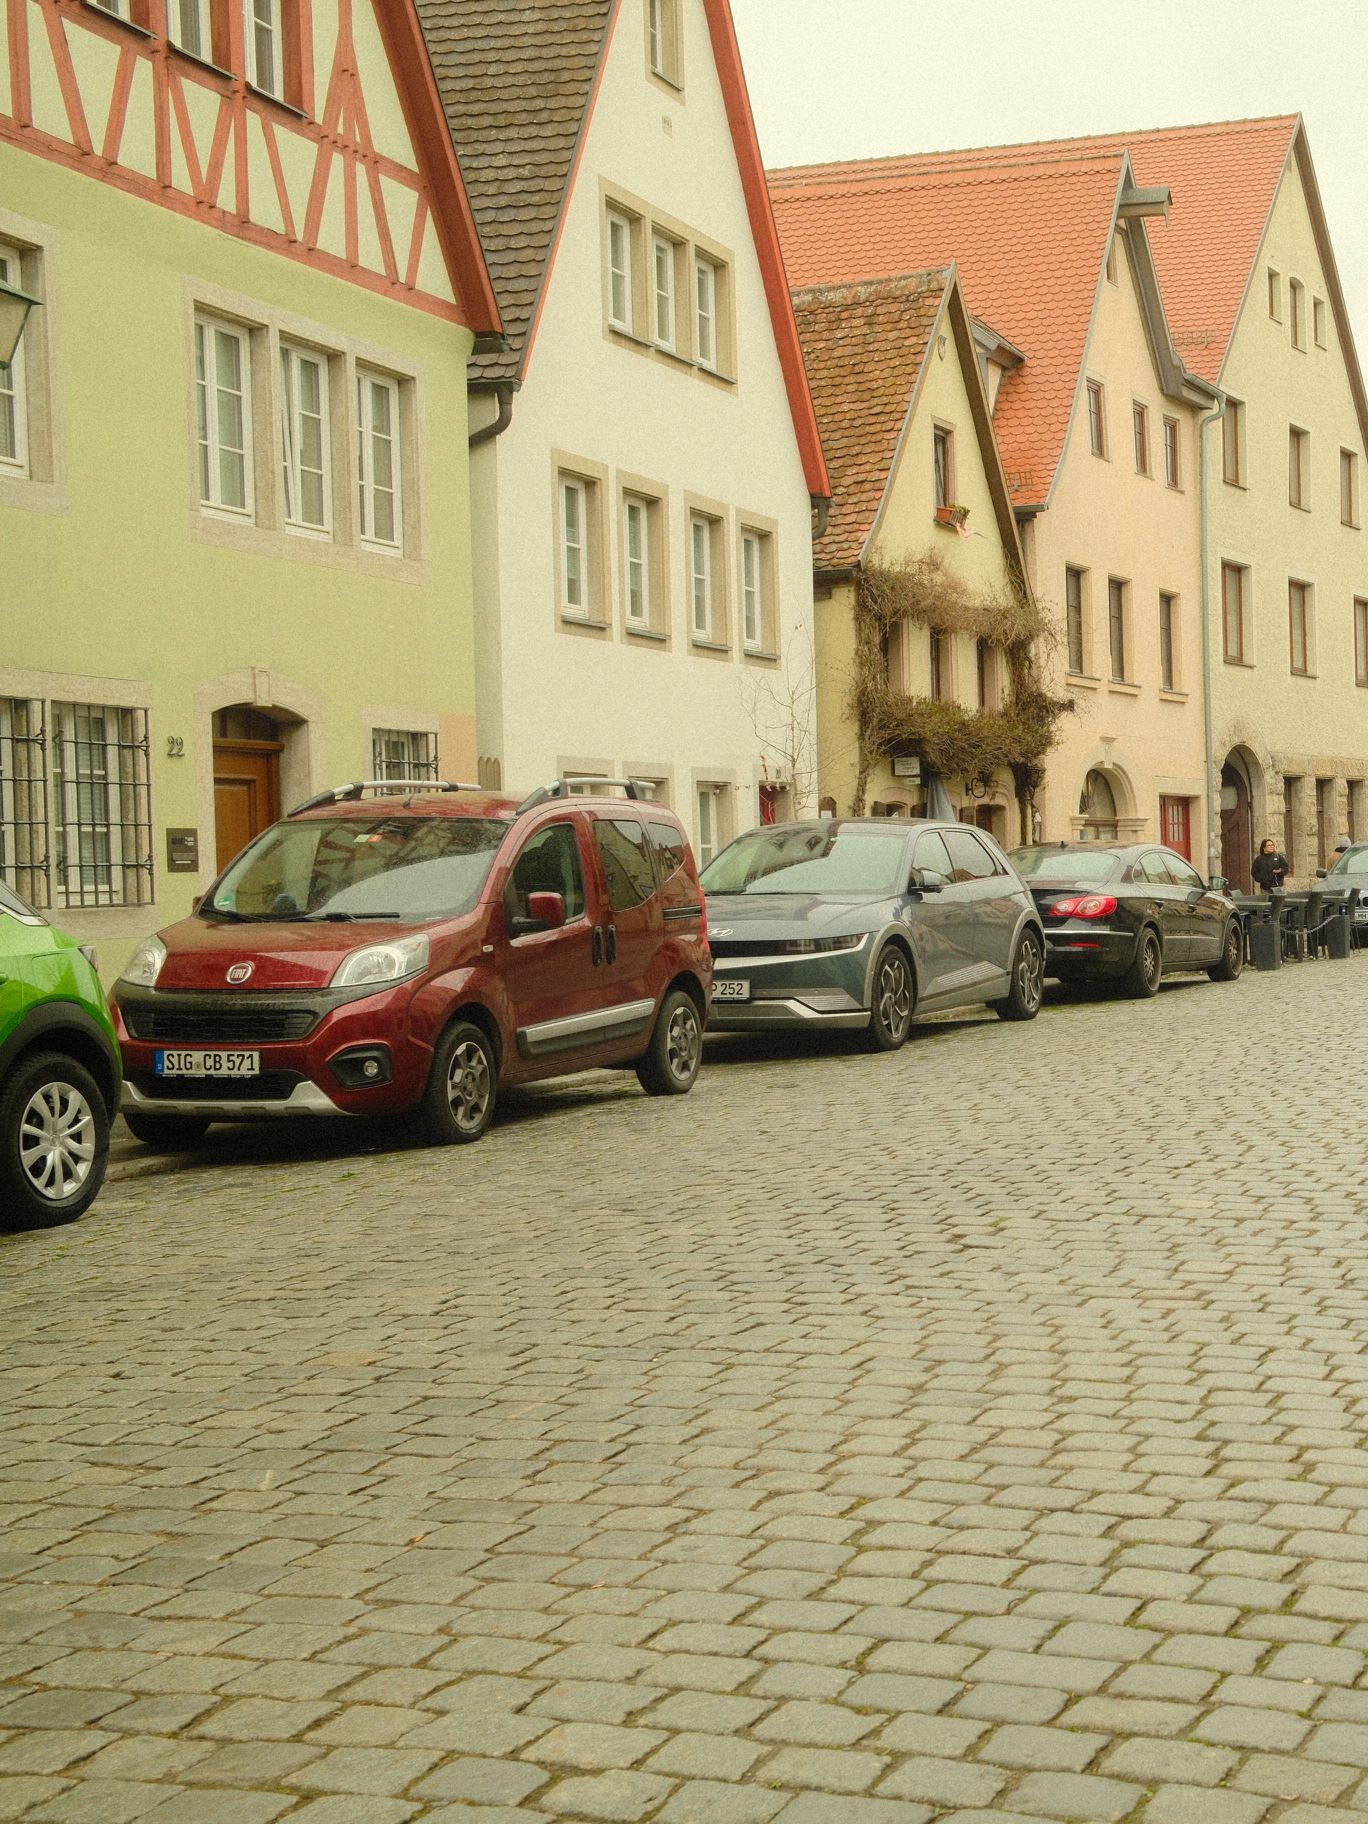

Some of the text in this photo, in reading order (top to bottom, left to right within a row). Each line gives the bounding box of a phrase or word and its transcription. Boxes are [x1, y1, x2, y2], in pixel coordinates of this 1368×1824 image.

[167, 735, 185, 758] 22
[231, 968, 247, 979] FIAT
[720, 982, 744, 996] 252
[166, 1053, 193, 1071] SIG
[203, 1053, 223, 1071] CB
[226, 1053, 256, 1071] 571
